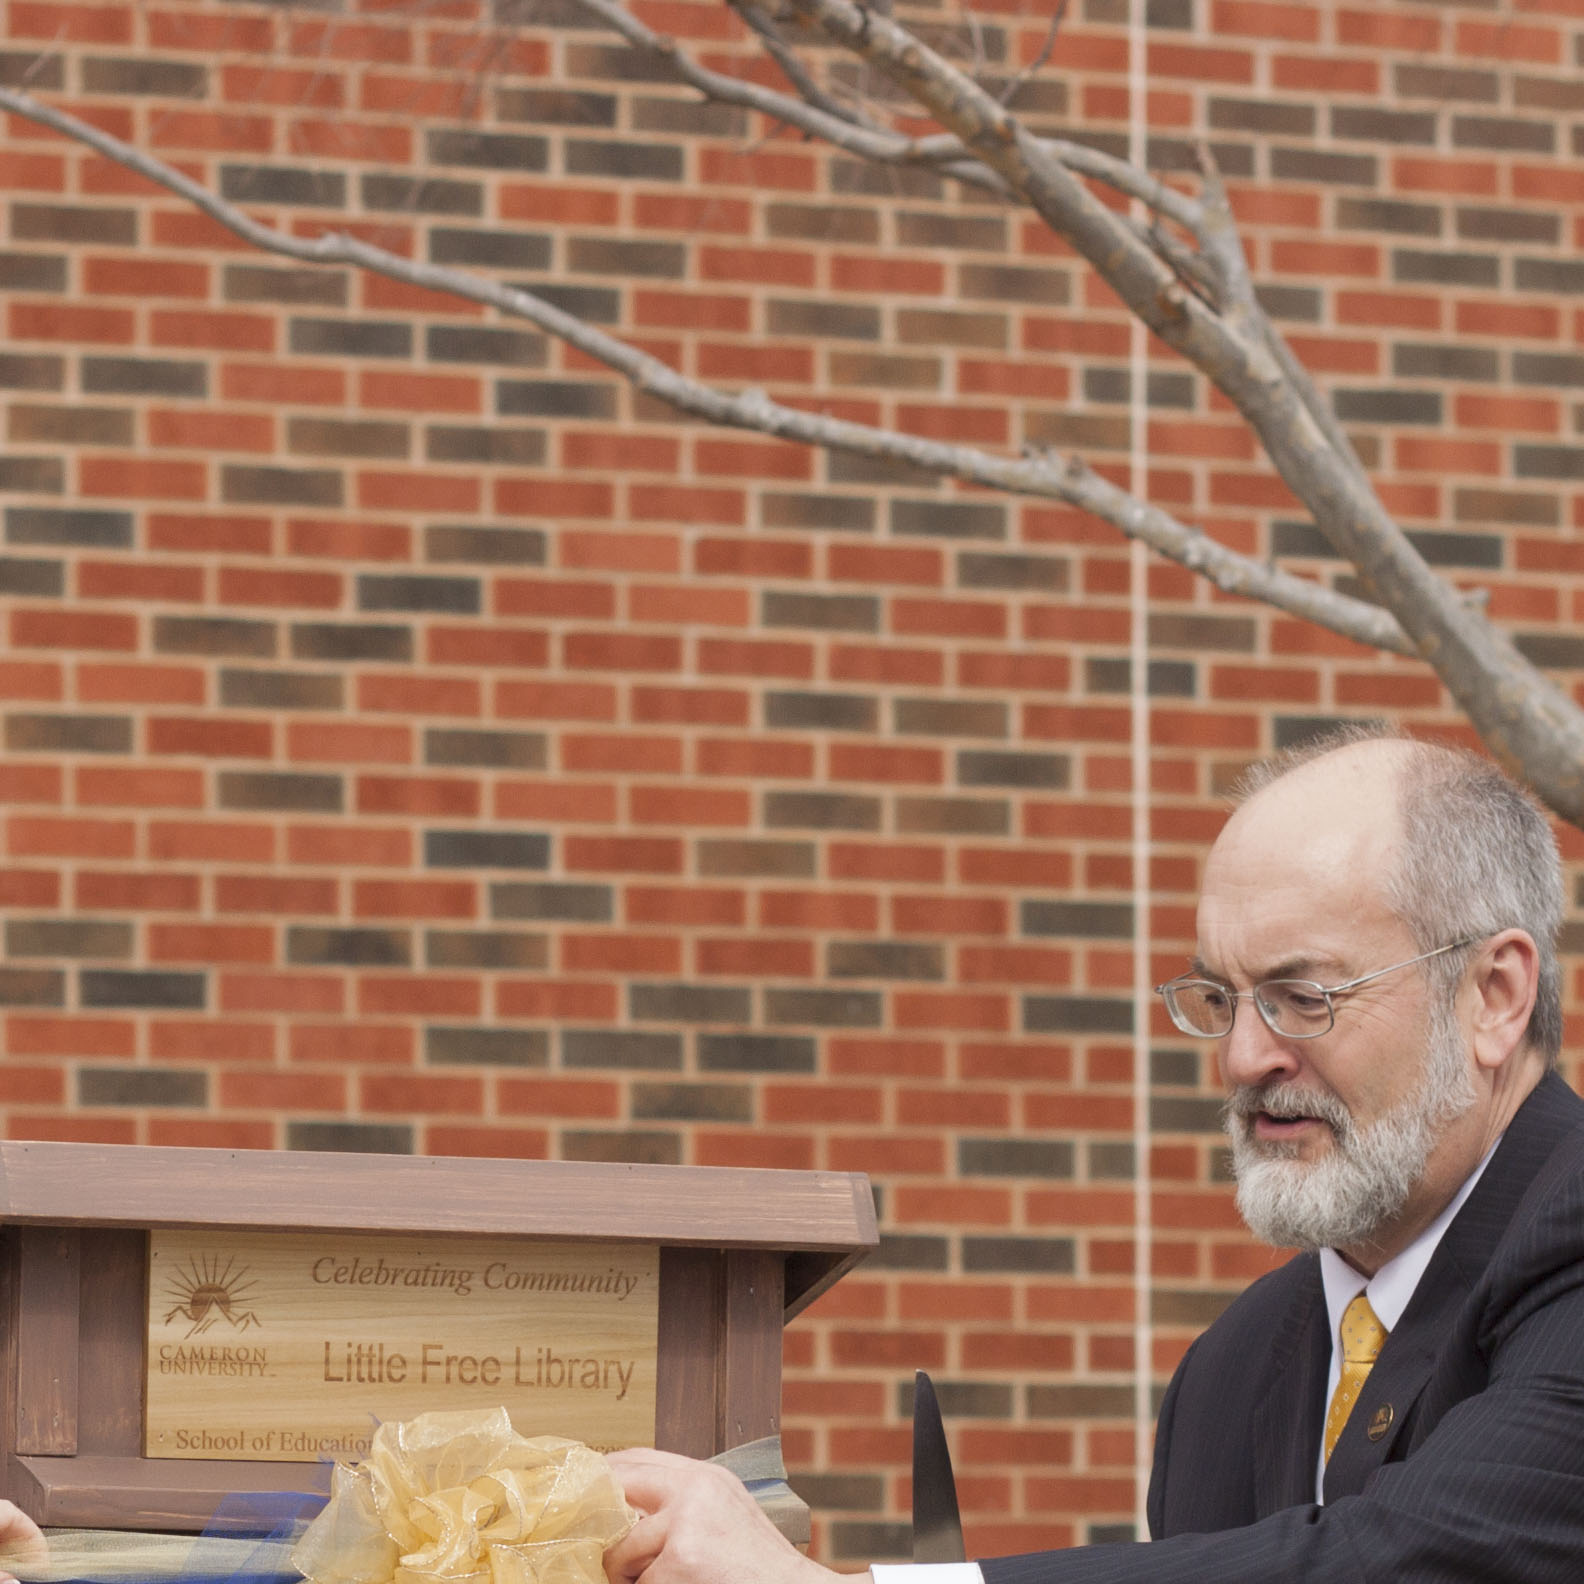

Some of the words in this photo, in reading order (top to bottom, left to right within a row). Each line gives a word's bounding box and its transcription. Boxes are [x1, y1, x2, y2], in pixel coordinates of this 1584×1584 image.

[312, 1256, 472, 1296] Celebrating
[483, 1262, 638, 1301] Community
[159, 1344, 267, 1361] CAMERON
[159, 1360, 268, 1377] UNIVERSITY
[323, 1341, 407, 1383] Little
[421, 1344, 501, 1386] Free
[514, 1346, 634, 1401] Library
[176, 1429, 245, 1450] School
[252, 1431, 276, 1451] of
